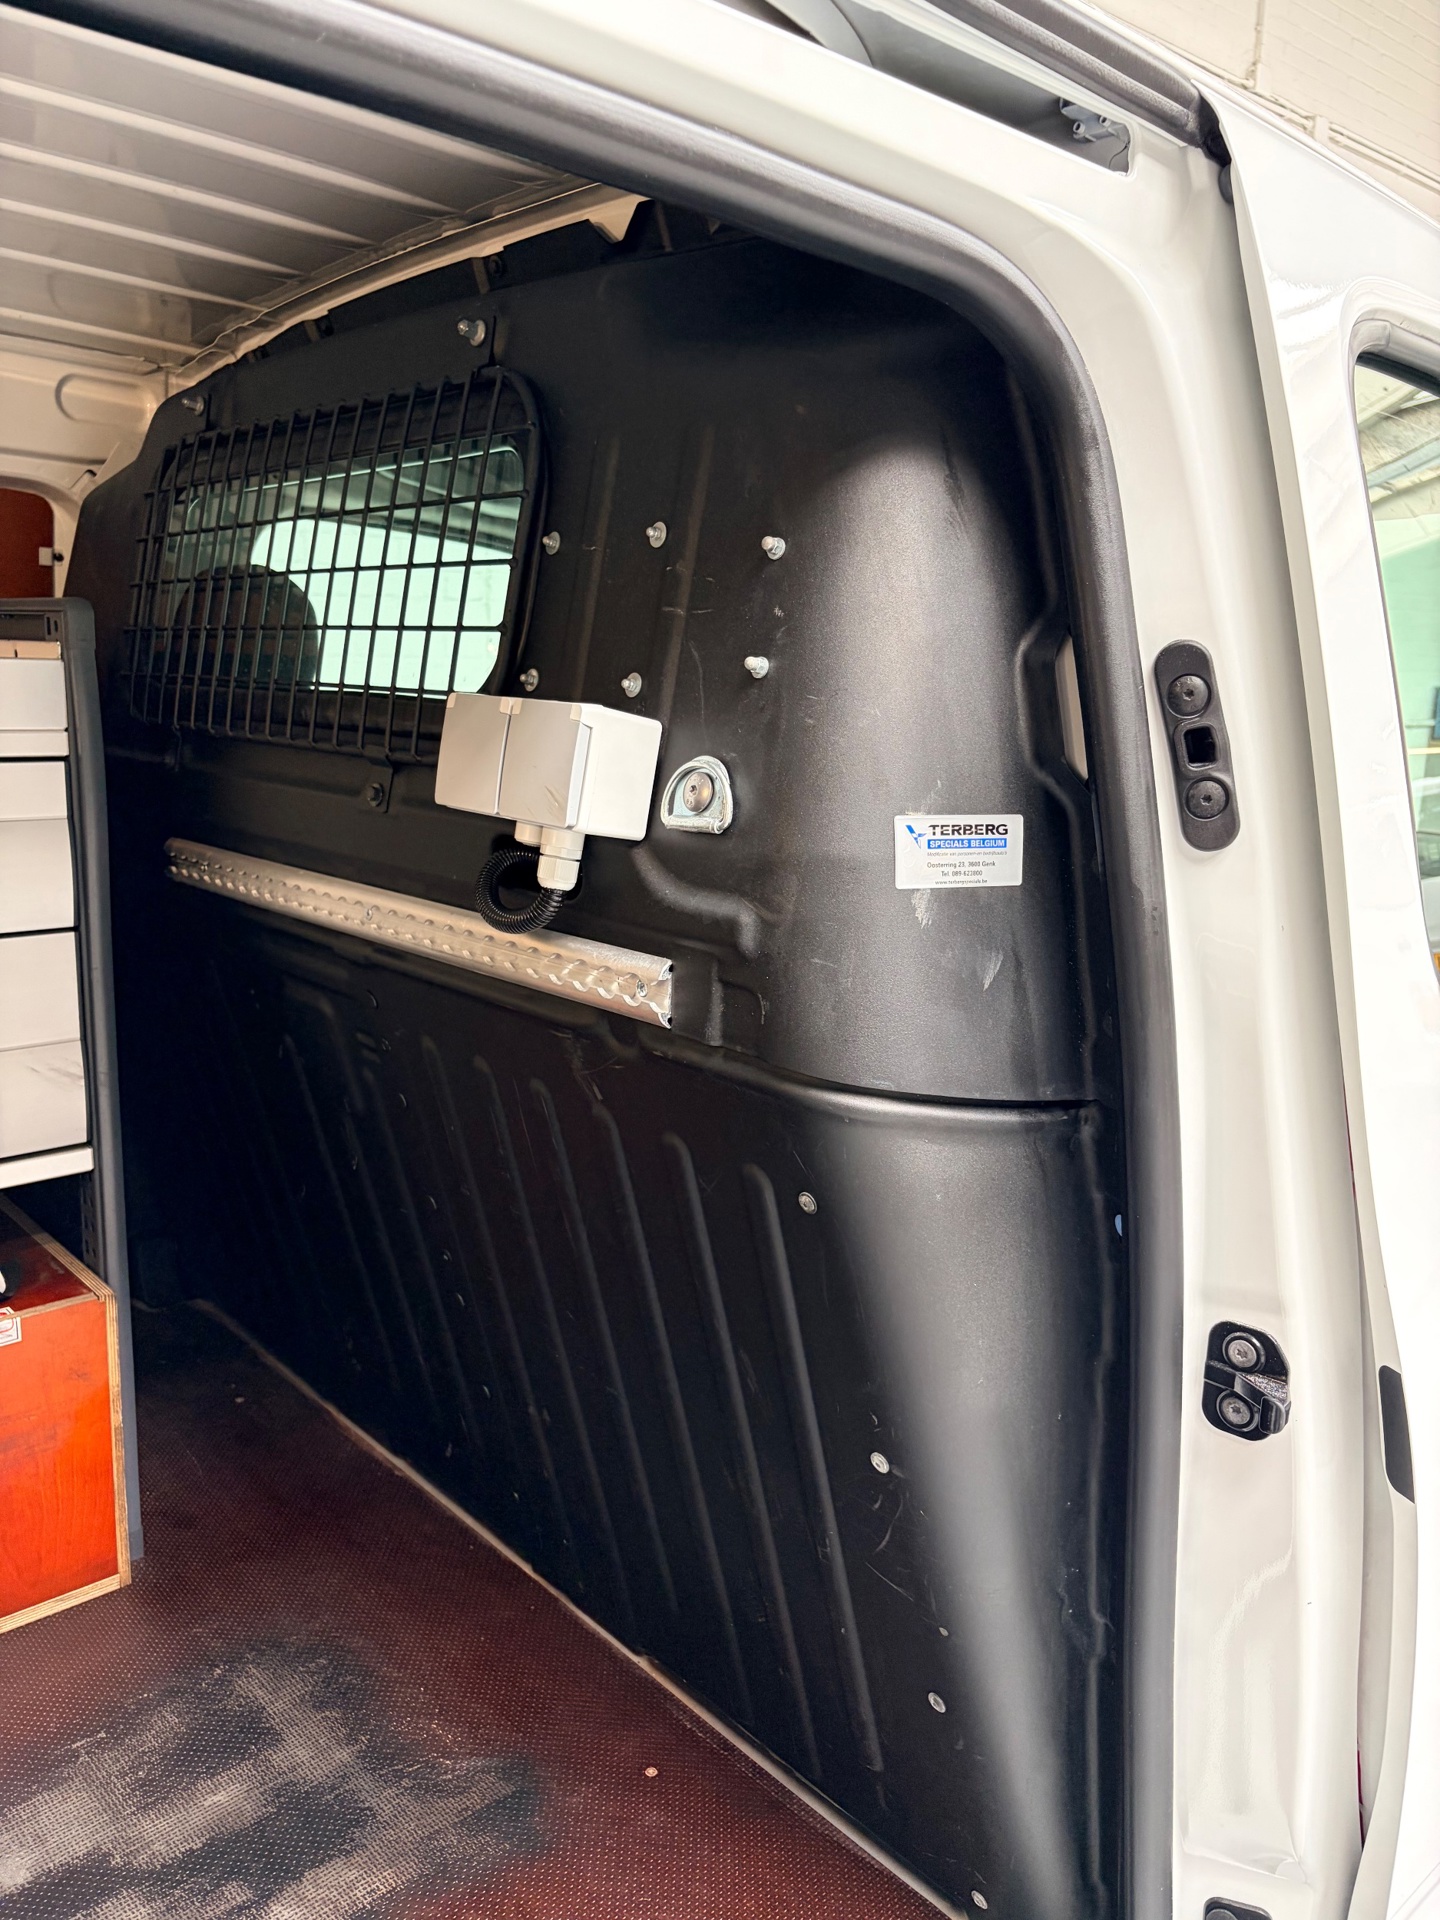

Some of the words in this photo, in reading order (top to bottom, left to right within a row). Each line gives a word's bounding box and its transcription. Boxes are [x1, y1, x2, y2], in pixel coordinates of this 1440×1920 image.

[928, 824, 1008, 836] TERBERG
[929, 840, 968, 848] SPECIALS
[971, 839, 1005, 847] BELGIUM
[927, 861, 957, 869] Oosterring
[981, 859, 996, 867] Genk
